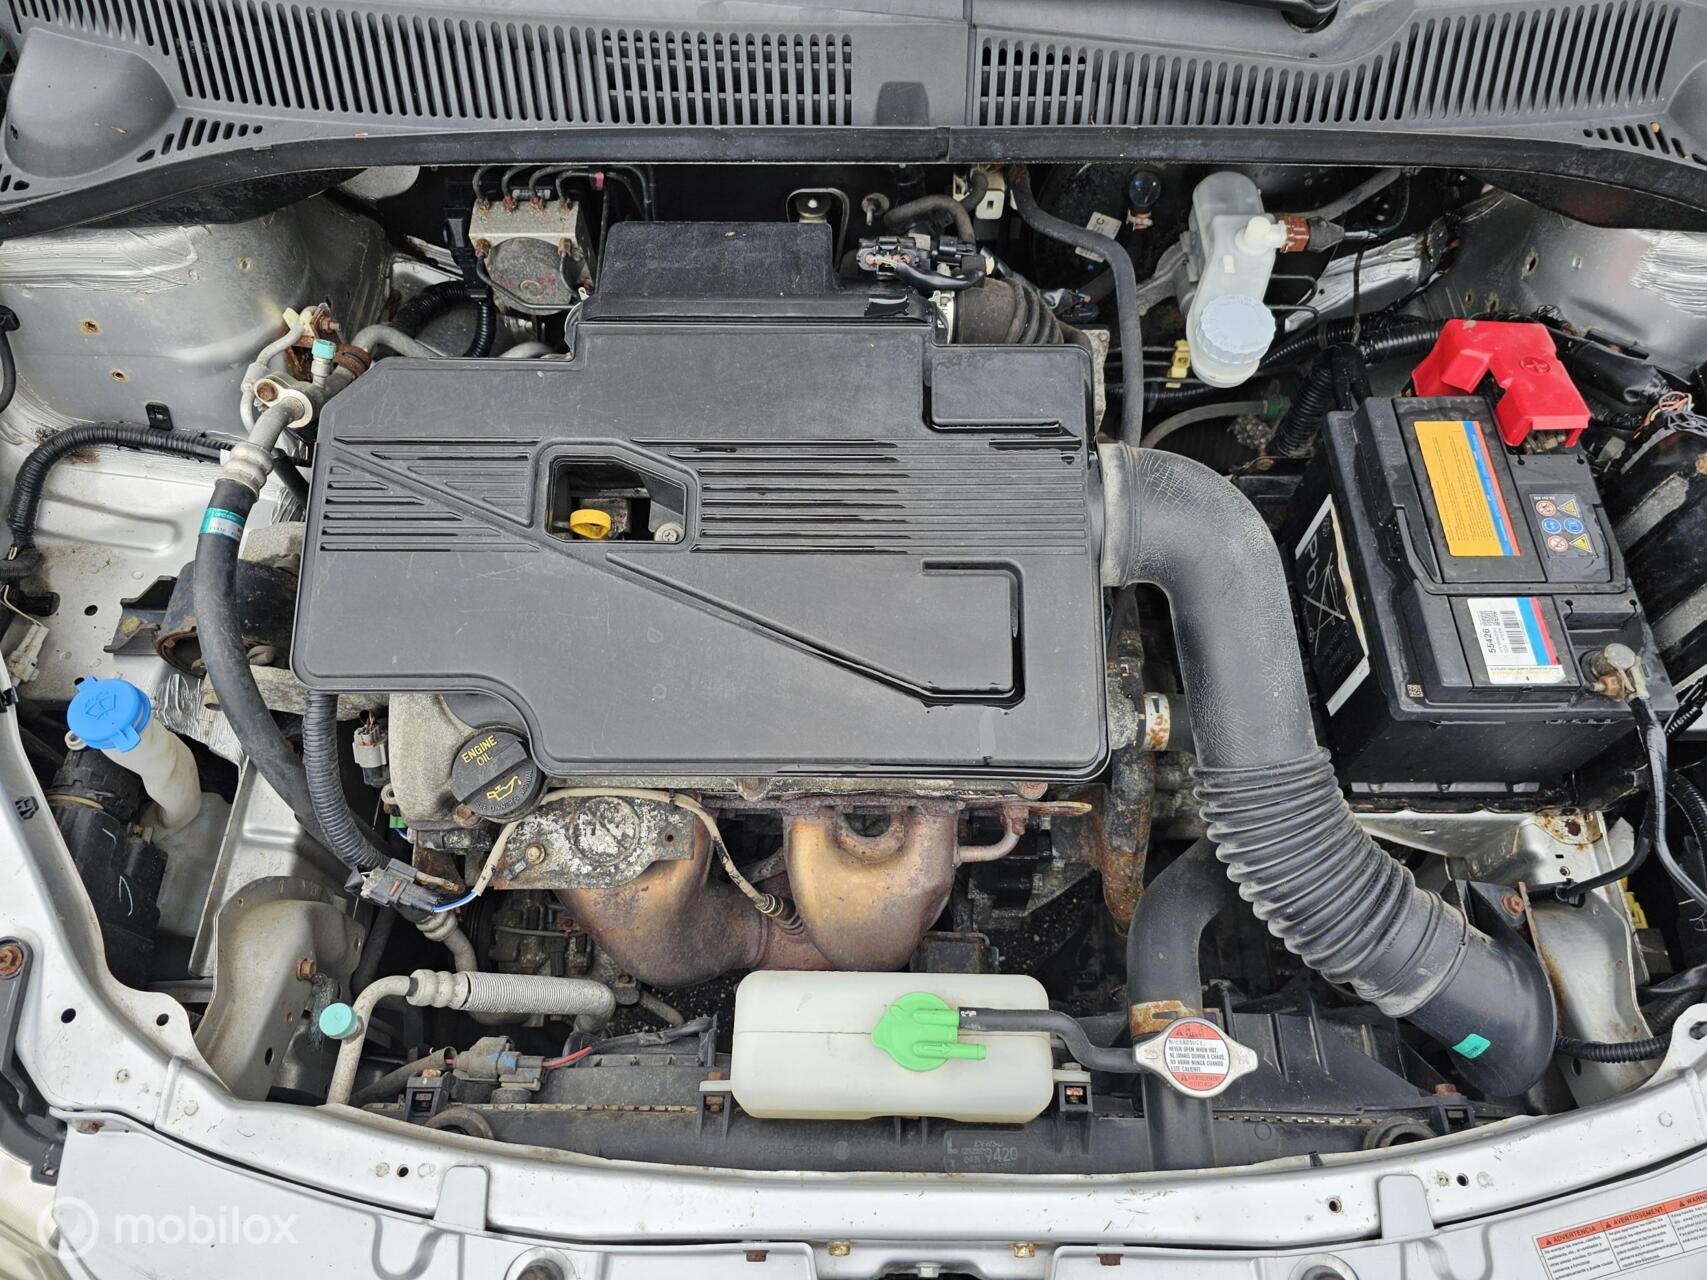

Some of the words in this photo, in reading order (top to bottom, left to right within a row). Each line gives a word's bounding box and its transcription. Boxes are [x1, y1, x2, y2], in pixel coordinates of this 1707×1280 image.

[1482, 628, 1497, 654] 55426
[462, 735, 497, 764] ENGINE
[476, 753, 493, 767] OIL
[1553, 1226, 1596, 1243] ADVERTENCIA
